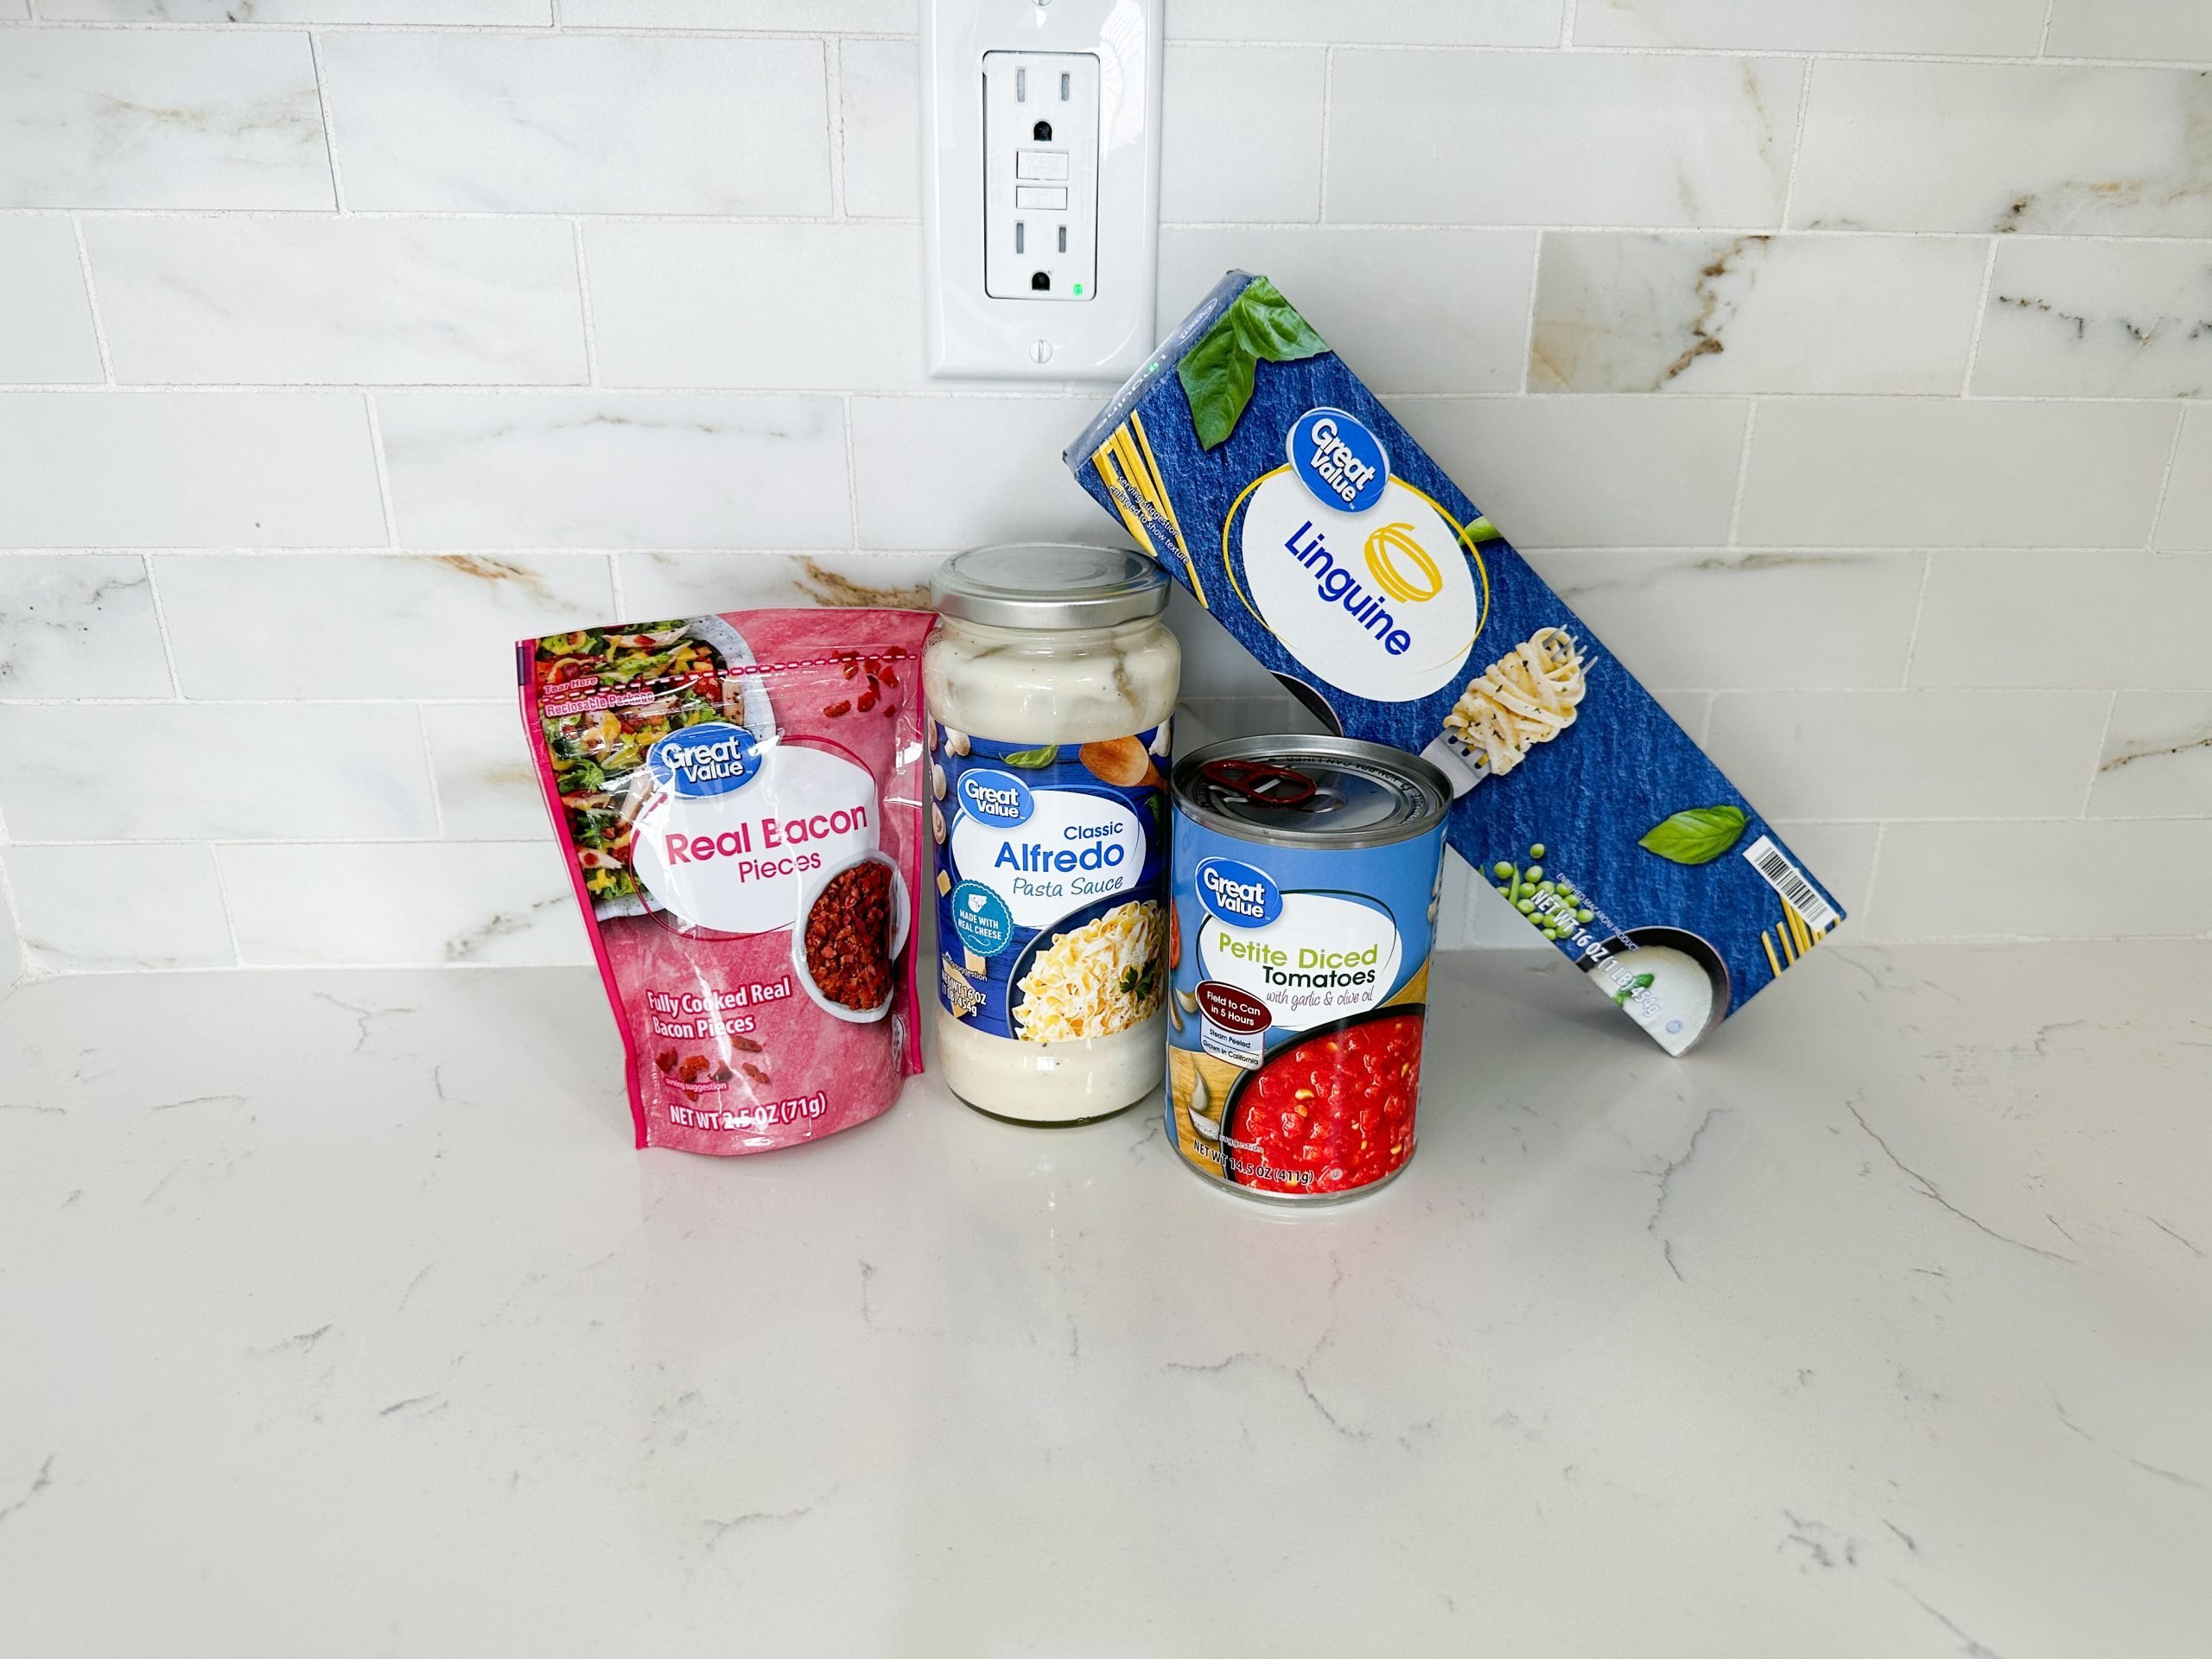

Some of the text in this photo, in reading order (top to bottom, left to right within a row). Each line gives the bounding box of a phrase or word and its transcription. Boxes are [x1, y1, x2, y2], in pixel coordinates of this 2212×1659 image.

[1311, 418, 1376, 491] Great
[1310, 448, 1356, 502] Value
[1117, 476, 1180, 538] serving suggestion
[1109, 486, 1190, 565] enlarged to show texture
[1284, 520, 1411, 655] Linguine
[544, 677, 599, 695] Tear Here
[545, 696, 607, 718] Reclosable
[661, 735, 743, 769] Great
[683, 760, 744, 783] Value
[964, 779, 1019, 806] Great
[976, 799, 1020, 819] Value
[665, 804, 868, 865] Real Bacon
[1064, 821, 1123, 841] Classic
[739, 852, 822, 883] Pieces
[994, 841, 1124, 873] Alfredo
[1013, 875, 1123, 898] Pasta Sauce
[1204, 867, 1265, 905] Great
[1215, 892, 1264, 918] Value
[1555, 872, 1639, 951] ENRICHED MACARONI PRODUCT
[957, 918, 1002, 941] REAL CHEESE
[959, 908, 999, 930] MADE WITH
[1219, 932, 1378, 969] Petite Diced
[1530, 889, 1560, 915] NET
[1553, 909, 1580, 933] WT
[1571, 927, 1592, 947] 16
[1585, 941, 1610, 963] OZ
[1630, 986, 1660, 1018] 454g
[1262, 965, 1376, 988] Tomatoes
[647, 977, 791, 1018] Fully Cooked Real
[950, 978, 962, 995] WT
[963, 986, 974, 1001] 16
[975, 991, 987, 1006] OZ
[1206, 990, 1261, 1016] Field to Can
[1266, 985, 1375, 1011] with garlic & olive oil
[957, 996, 977, 1018] 454g
[1211, 1004, 1255, 1027] in 5 Hours
[652, 1016, 754, 1038] Bacon Pieces
[1209, 1028, 1251, 1049] Steam Peeled
[1202, 1039, 1221, 1053] Grown
[1228, 1051, 1259, 1065] California
[685, 1082, 727, 1093] suggestion
[670, 1105, 695, 1127] NET
[695, 1111, 719, 1130] WT
[753, 1105, 778, 1128] OZ
[779, 1092, 826, 1122] (71g)
[1193, 1140, 1210, 1158] NET
[1211, 1150, 1229, 1167] WT
[1230, 1158, 1254, 1175] 14.5
[1255, 1166, 1274, 1179] OZ
[1274, 1168, 1315, 1185] (411g)
